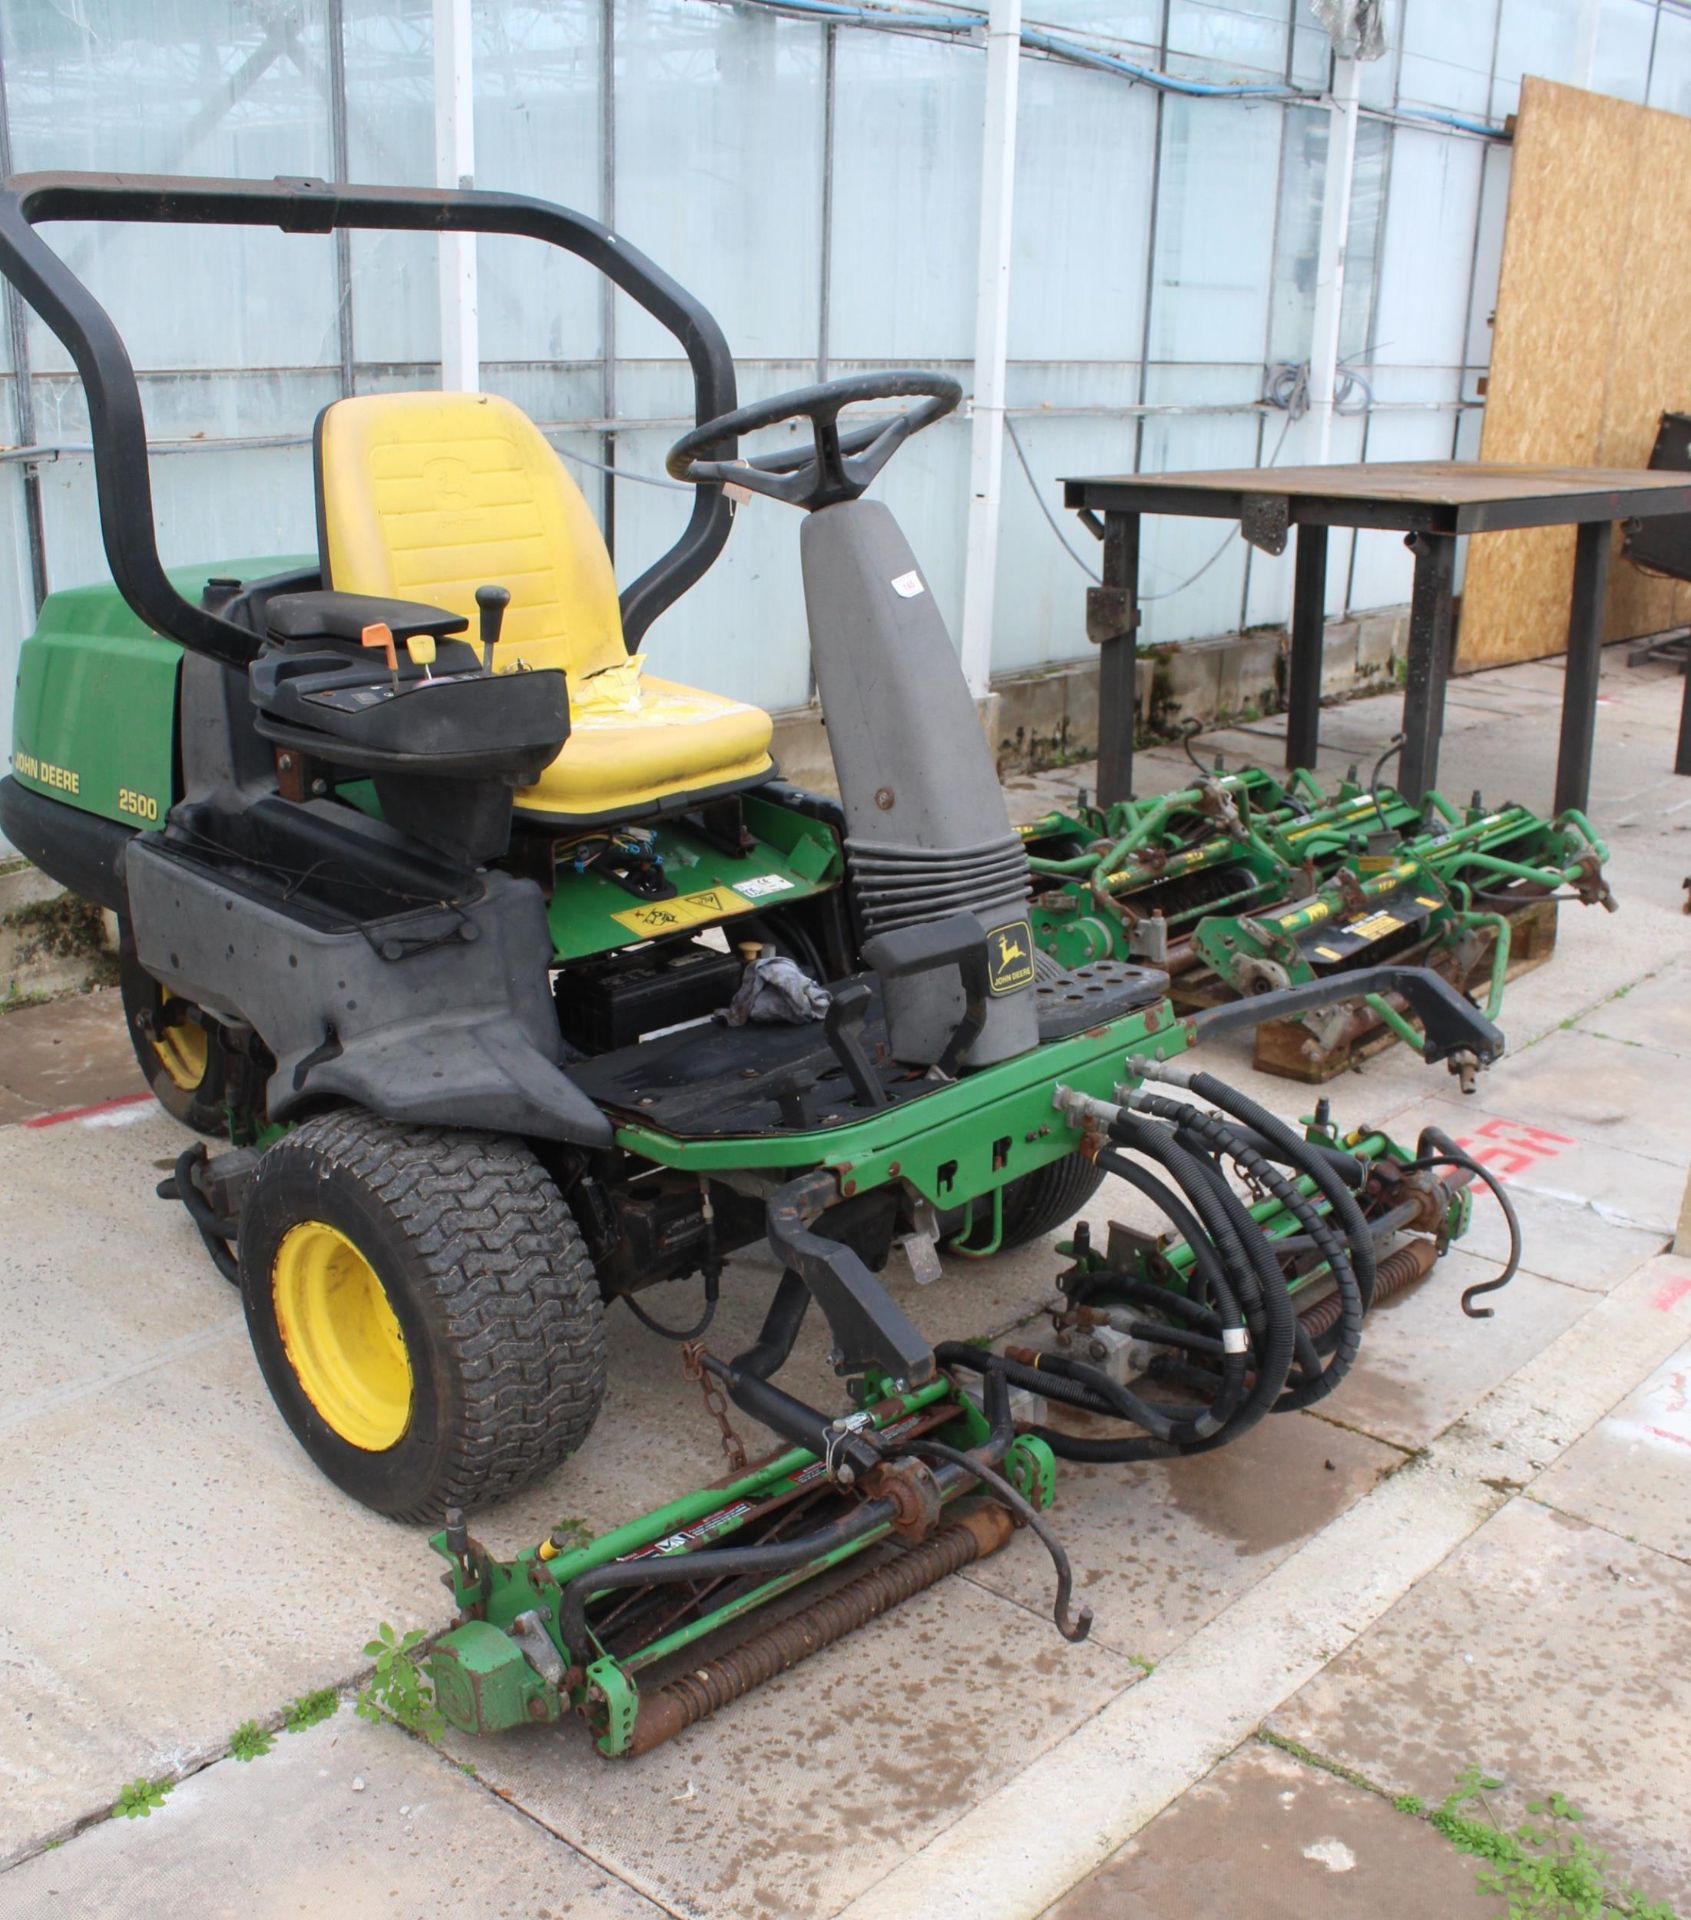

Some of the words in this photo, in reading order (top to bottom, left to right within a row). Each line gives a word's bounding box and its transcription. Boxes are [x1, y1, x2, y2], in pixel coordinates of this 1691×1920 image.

[15, 752, 38, 779] JOHN
[41, 762, 79, 794] DEERE
[119, 788, 157, 820] 2500
[994, 975, 1011, 986] JOHN
[1012, 967, 1031, 981] DEERE
